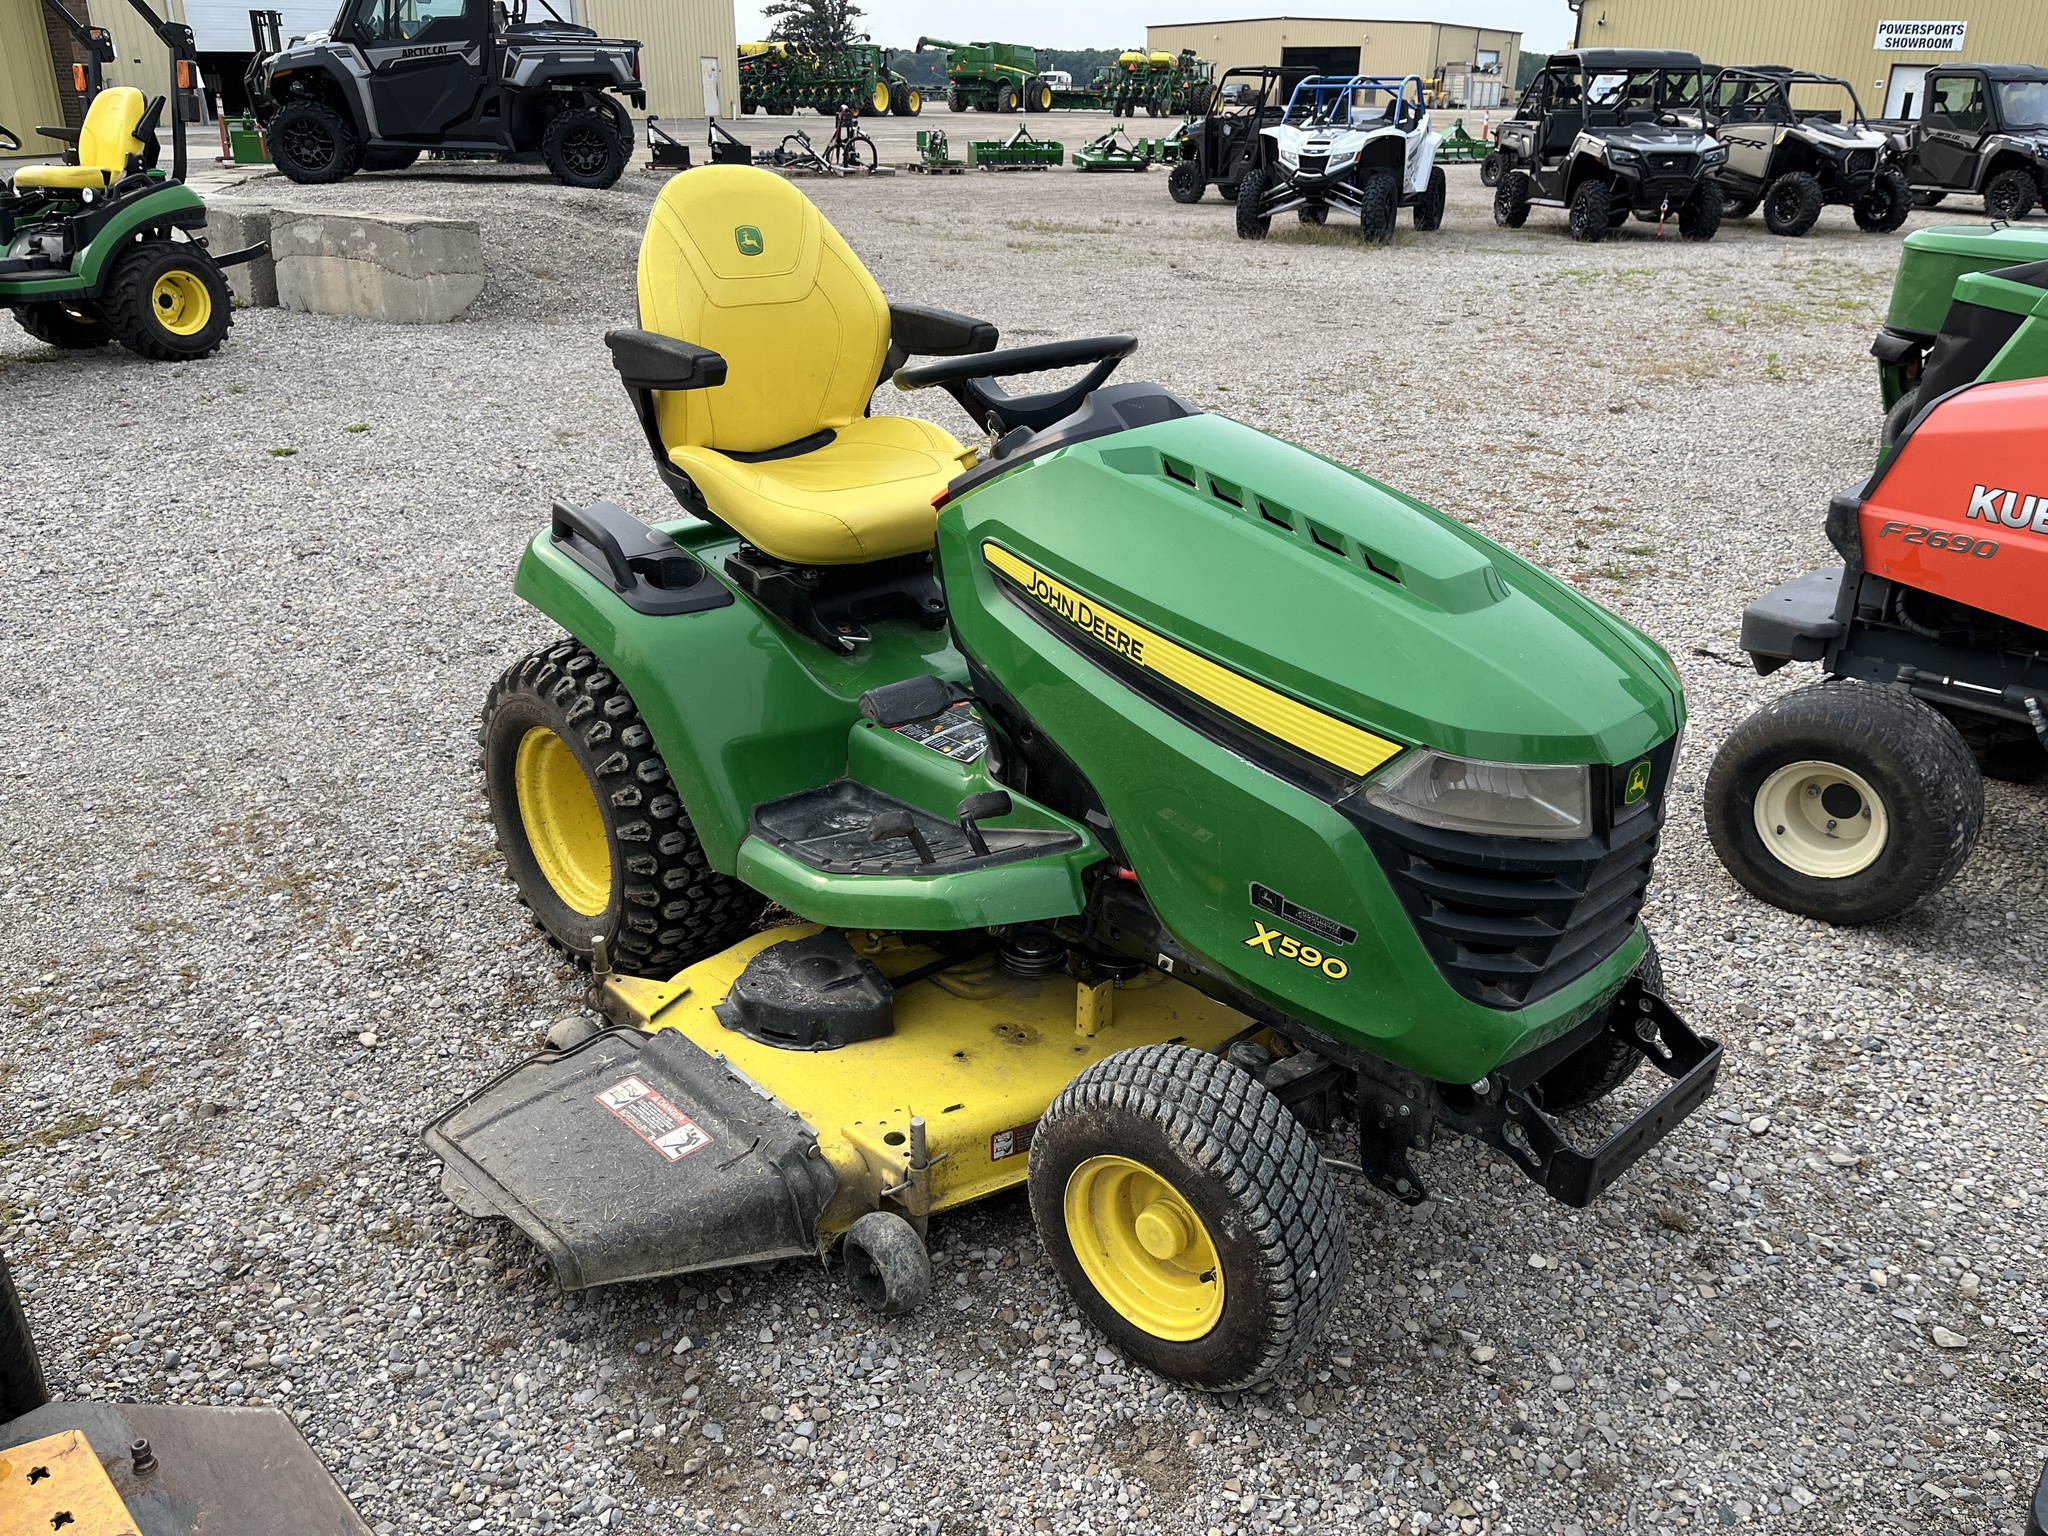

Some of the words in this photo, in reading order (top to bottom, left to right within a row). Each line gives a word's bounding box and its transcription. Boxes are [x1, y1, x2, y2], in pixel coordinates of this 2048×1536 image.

[1879, 24, 1964, 35] POWERSPORTS
[401, 47, 430, 58] ARCTIC
[433, 46, 448, 55] CAT
[1885, 37, 1953, 48] SHOWROOM
[1878, 521, 1999, 559] F2690
[1027, 571, 1074, 618] JOHN
[1079, 602, 1144, 662] DEERE
[1242, 918, 1349, 979] X590
[658, 1097, 686, 1121] DANGER
